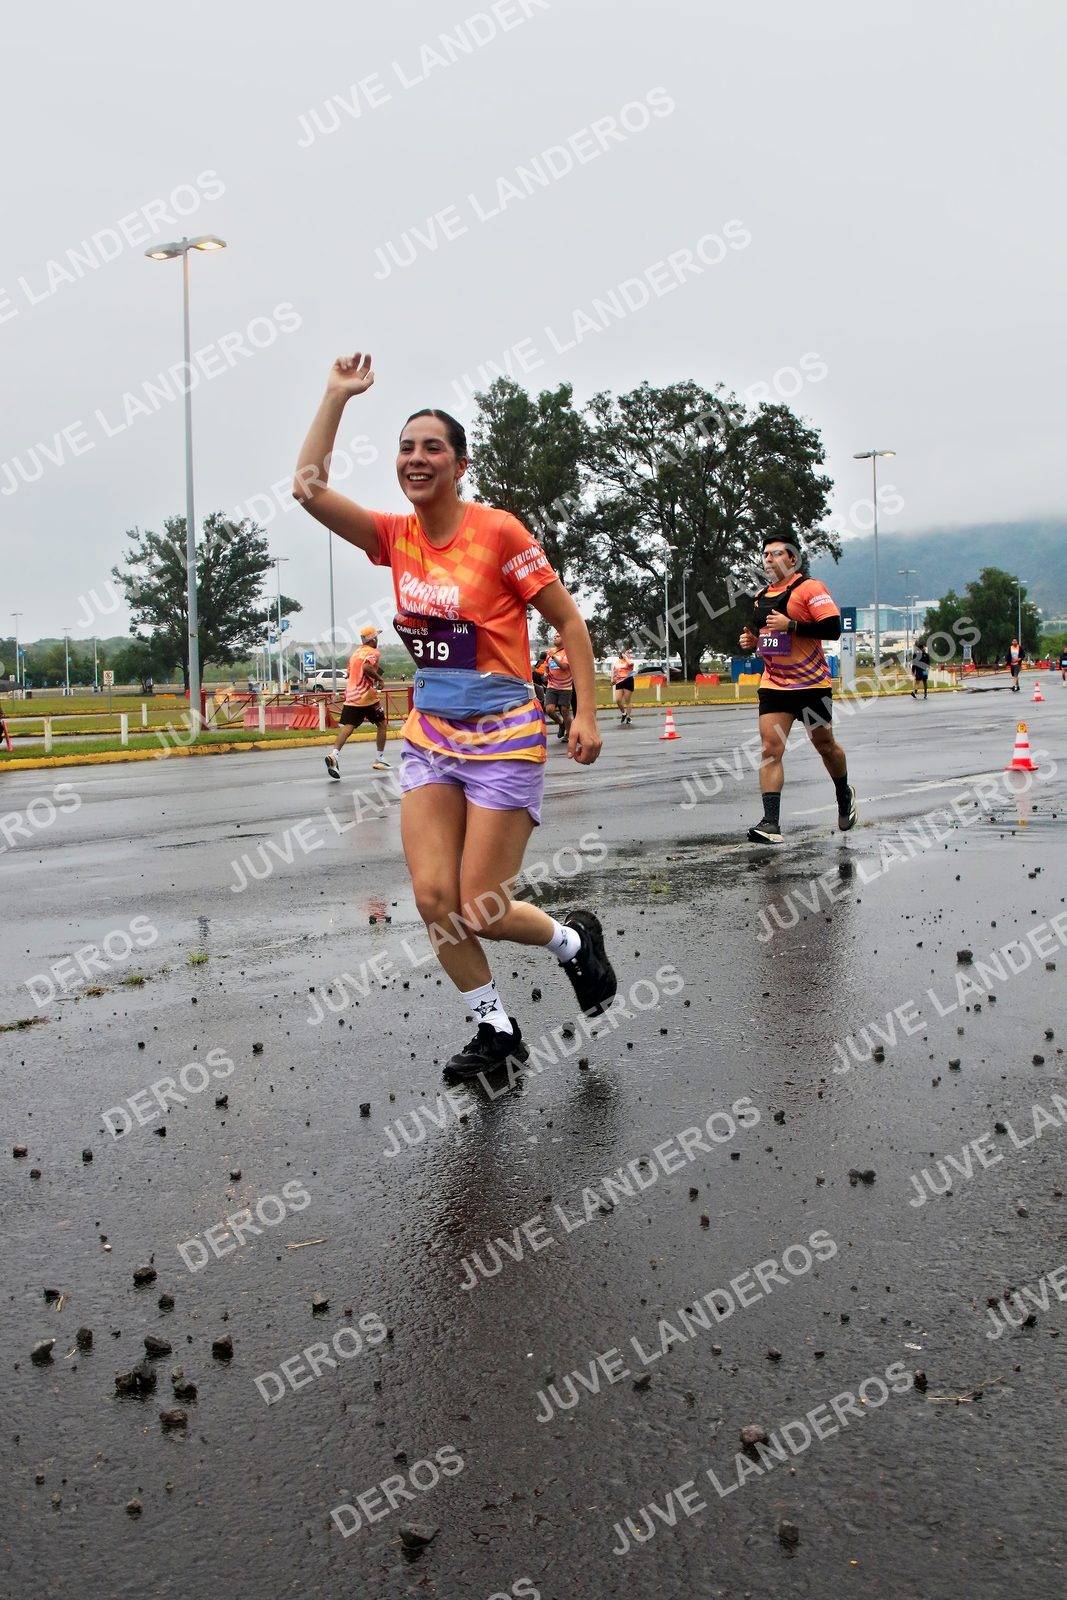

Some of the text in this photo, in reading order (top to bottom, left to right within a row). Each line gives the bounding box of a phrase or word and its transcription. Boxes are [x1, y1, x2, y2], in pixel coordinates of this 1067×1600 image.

[452, 623, 469, 634] 15K
[843, 617, 852, 630] E
[762, 638, 779, 648] 378
[412, 639, 450, 661] 319
